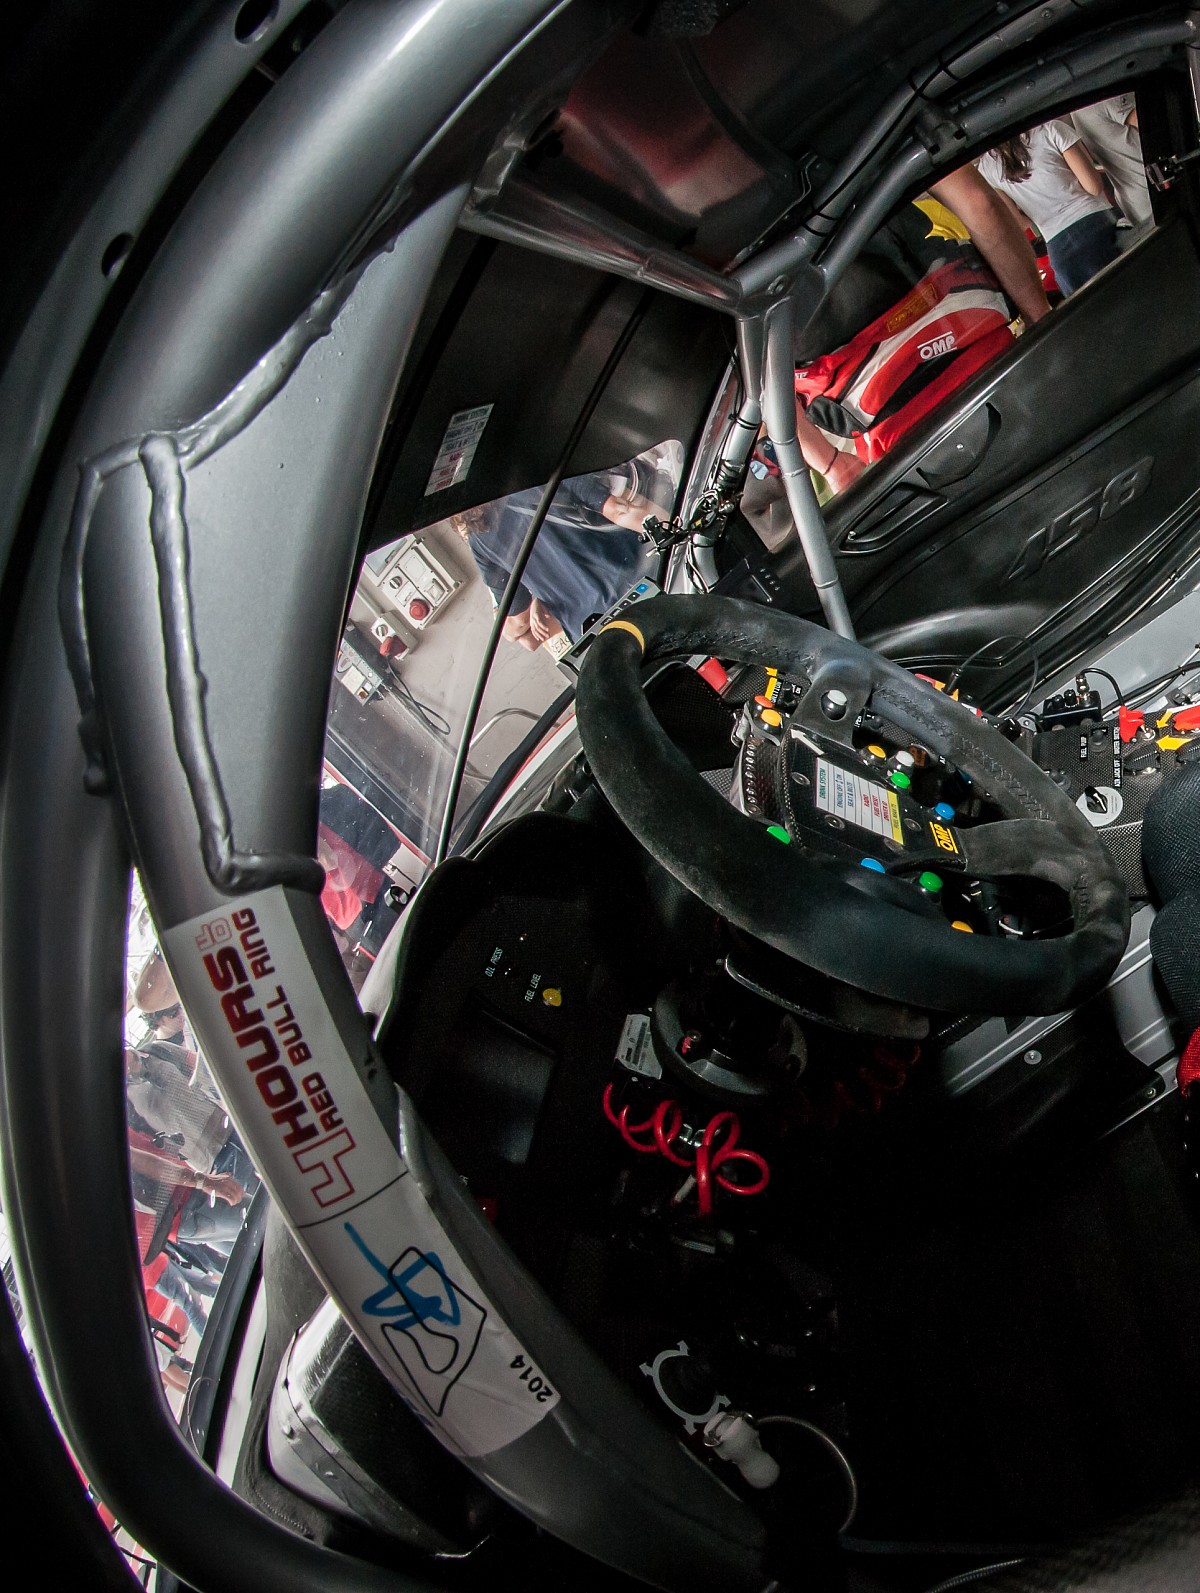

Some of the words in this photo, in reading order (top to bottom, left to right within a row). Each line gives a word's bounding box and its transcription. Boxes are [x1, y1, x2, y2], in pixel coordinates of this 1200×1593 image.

[919, 333, 956, 360] OMP
[1003, 456, 1155, 582] 458
[932, 823, 955, 852] OMP
[195, 916, 232, 952] OF
[231, 907, 276, 980] RING
[484, 966, 496, 977] OIL
[490, 947, 504, 965] PRESS
[524, 989, 536, 1002] FUEL
[530, 973, 542, 989] LEVEL
[202, 945, 320, 1148] HOURS
[267, 985, 312, 1068] BULL
[302, 1071, 344, 1130] RED
[510, 1354, 554, 1403] 2014
